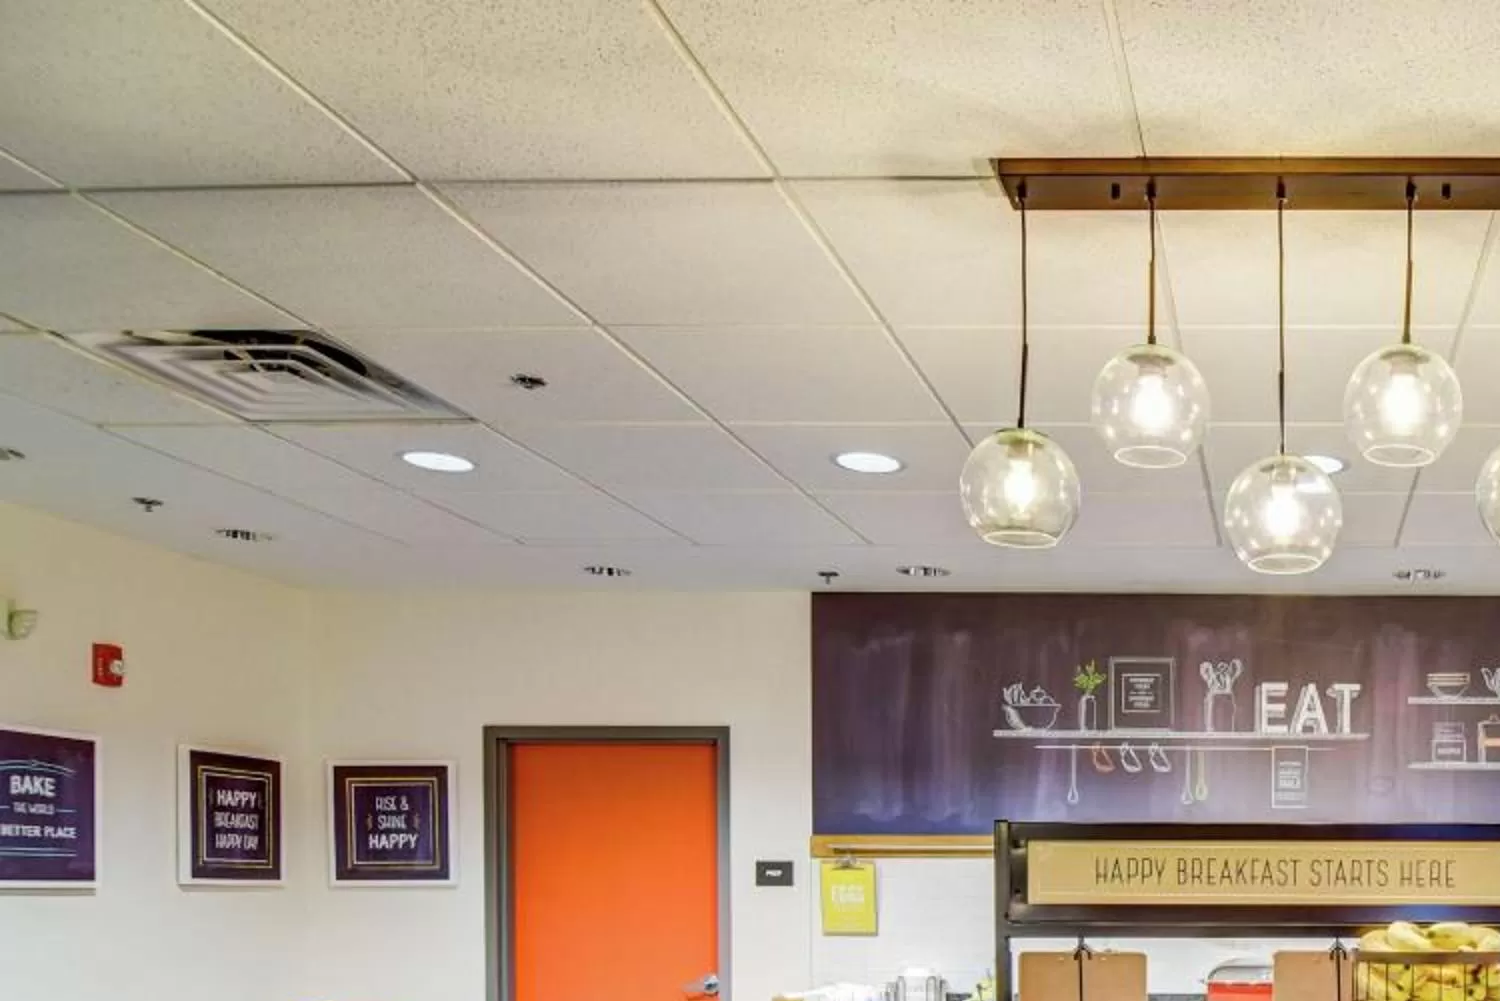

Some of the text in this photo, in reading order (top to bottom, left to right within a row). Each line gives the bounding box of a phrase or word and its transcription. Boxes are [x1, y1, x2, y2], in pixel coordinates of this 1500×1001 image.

[1254, 682, 1362, 735] EAT
[9, 774, 57, 798] BAKE
[216, 789, 257, 809] HAPPY
[375, 796, 409, 811] RISE &
[214, 811, 259, 830] BREAKFAST
[377, 814, 407, 830] SHINE
[0, 823, 77, 839] BETTER PLACE
[215, 833, 259, 850] HAPPY DAY
[367, 833, 418, 849] HAPPY
[1095, 857, 1457, 888] HAPPY BREAKFAST STARTS HERE
